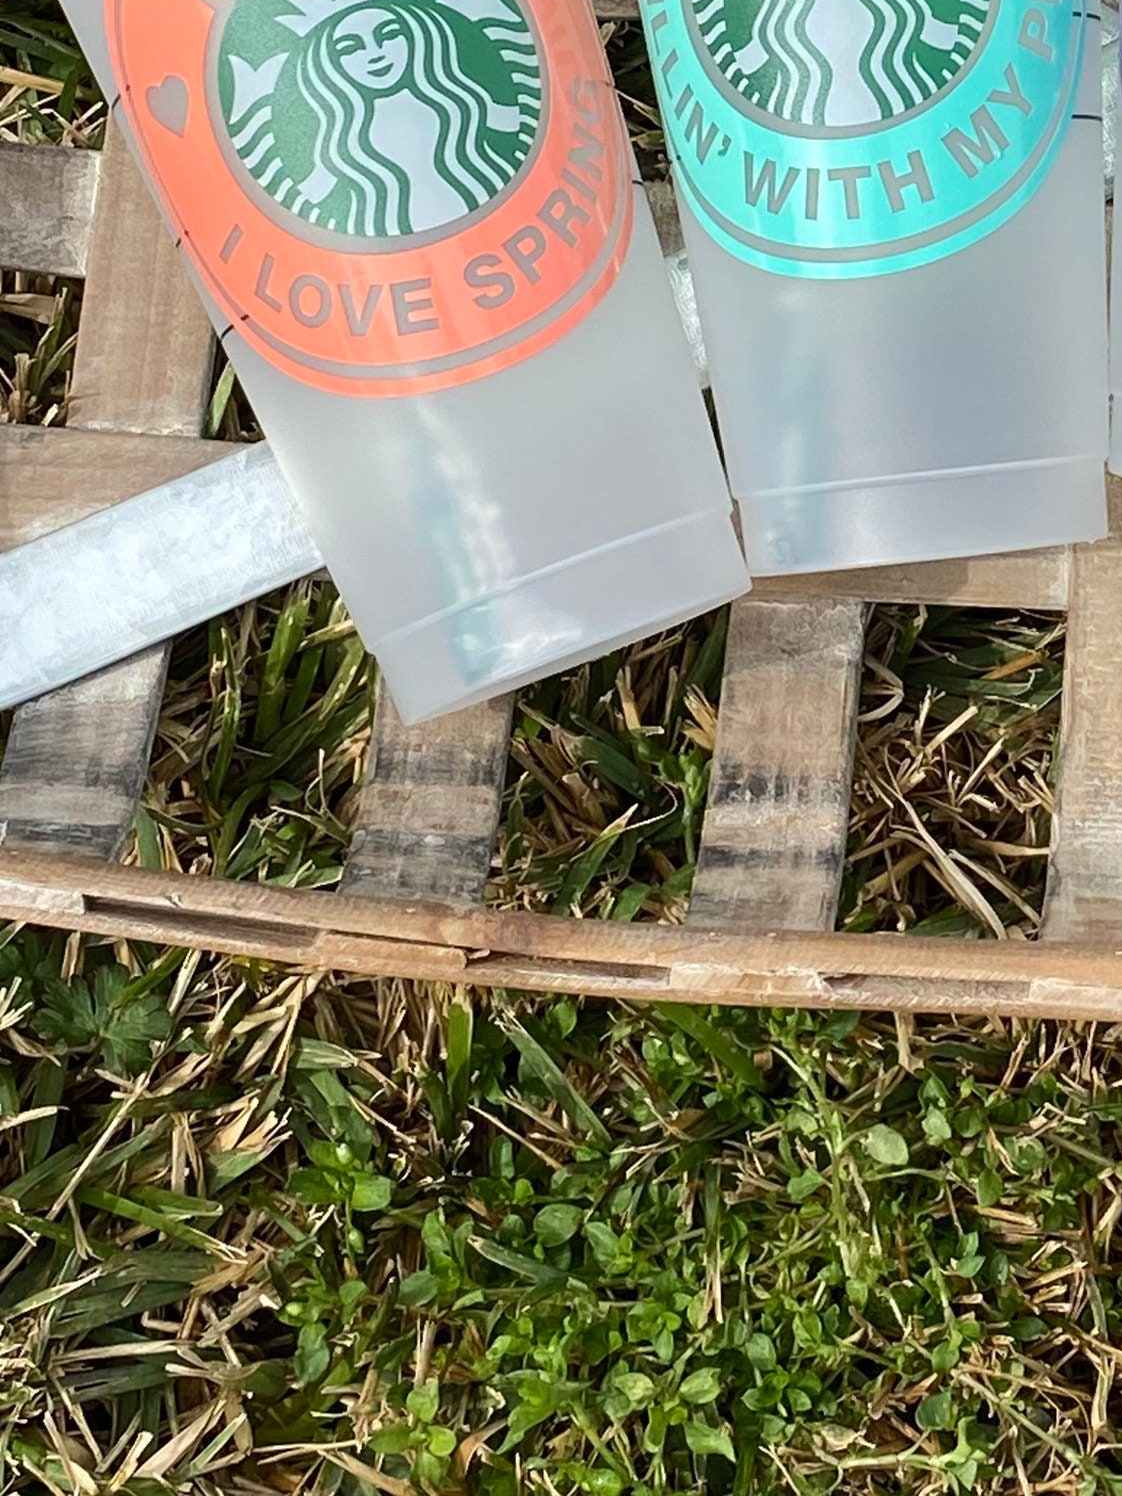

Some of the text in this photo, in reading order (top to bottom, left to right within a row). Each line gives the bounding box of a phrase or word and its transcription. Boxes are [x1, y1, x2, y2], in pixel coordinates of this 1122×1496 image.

[218, 77, 609, 336] I LOVE SPRING
[743, 149, 936, 221] WITH
[941, 66, 1033, 178] MY
